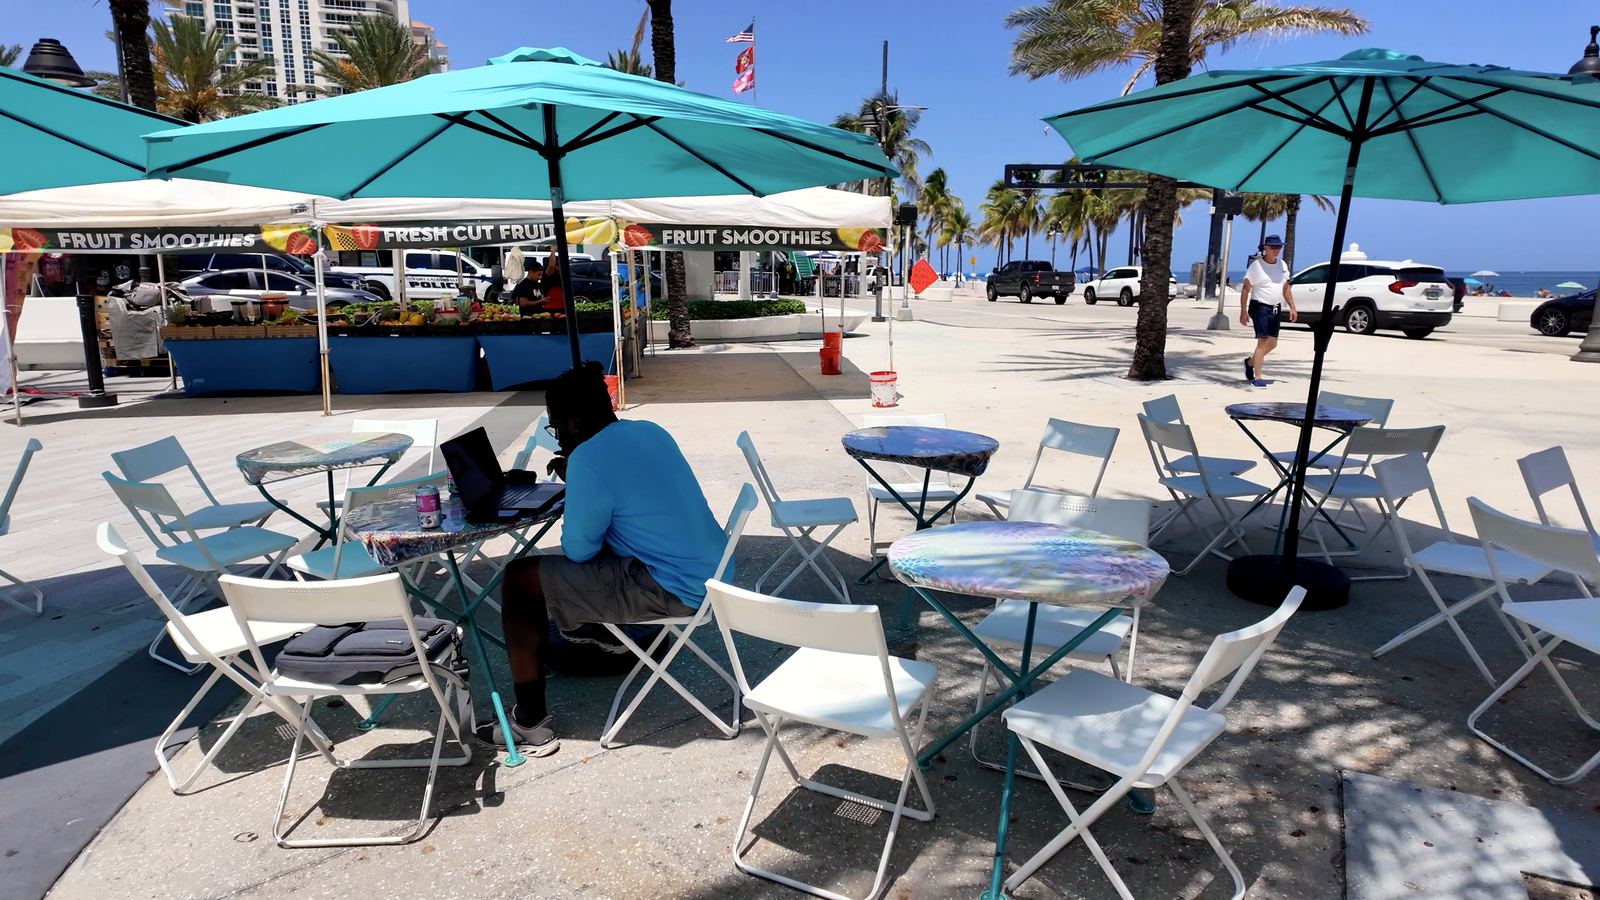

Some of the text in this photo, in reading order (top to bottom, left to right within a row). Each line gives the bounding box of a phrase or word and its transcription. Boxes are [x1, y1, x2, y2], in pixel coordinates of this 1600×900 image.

[57, 232, 256, 249] FRUIT SMOOTHIES
[384, 224, 556, 243] FRESH CUT FRUIT
[662, 229, 833, 245] FRUIT SMOOTHIES
